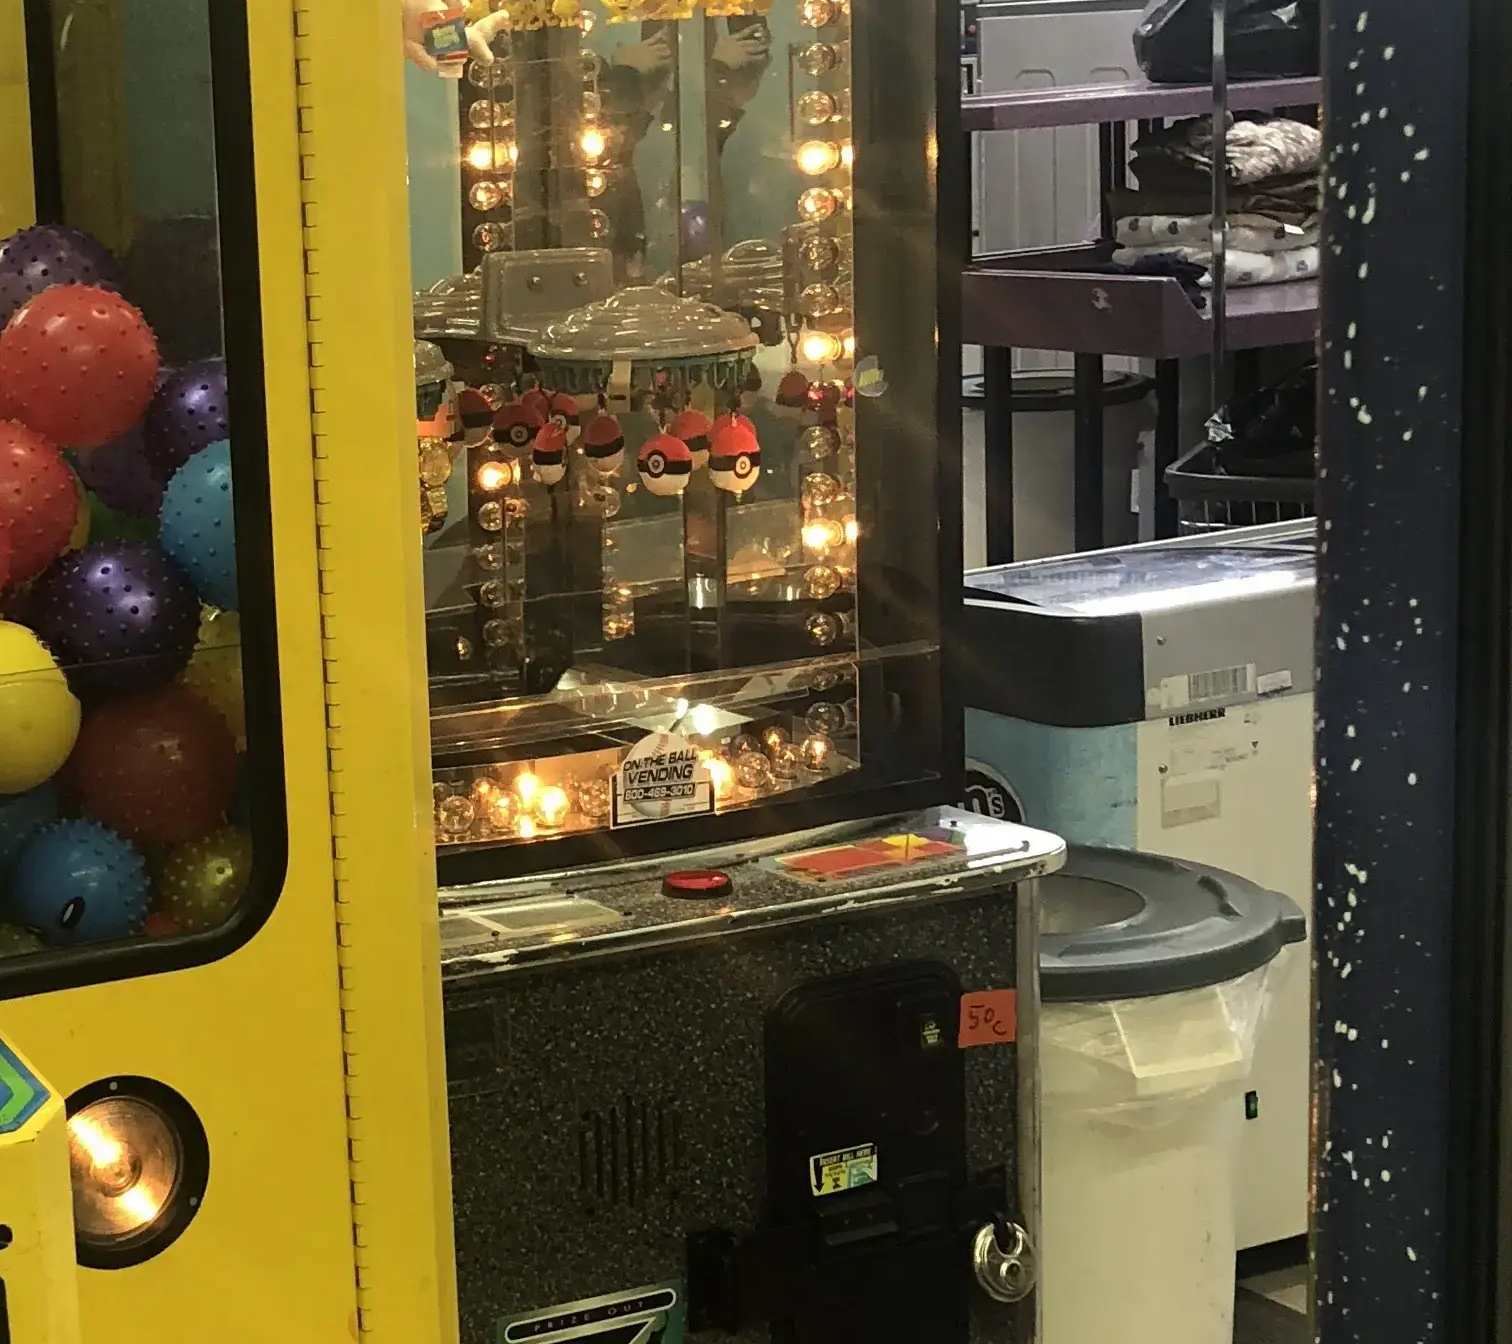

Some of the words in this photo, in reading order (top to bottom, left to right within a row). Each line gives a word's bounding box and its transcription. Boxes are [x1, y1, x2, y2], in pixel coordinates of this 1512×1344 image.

[1169, 707, 1226, 727] LIEBHERR
[623, 759, 641, 772] ON
[643, 753, 667, 768] THE
[668, 748, 697, 765] BALL
[628, 763, 694, 784] VENDING
[534, 1313, 591, 1332] PRIZE
[607, 1301, 644, 1316] OUT
